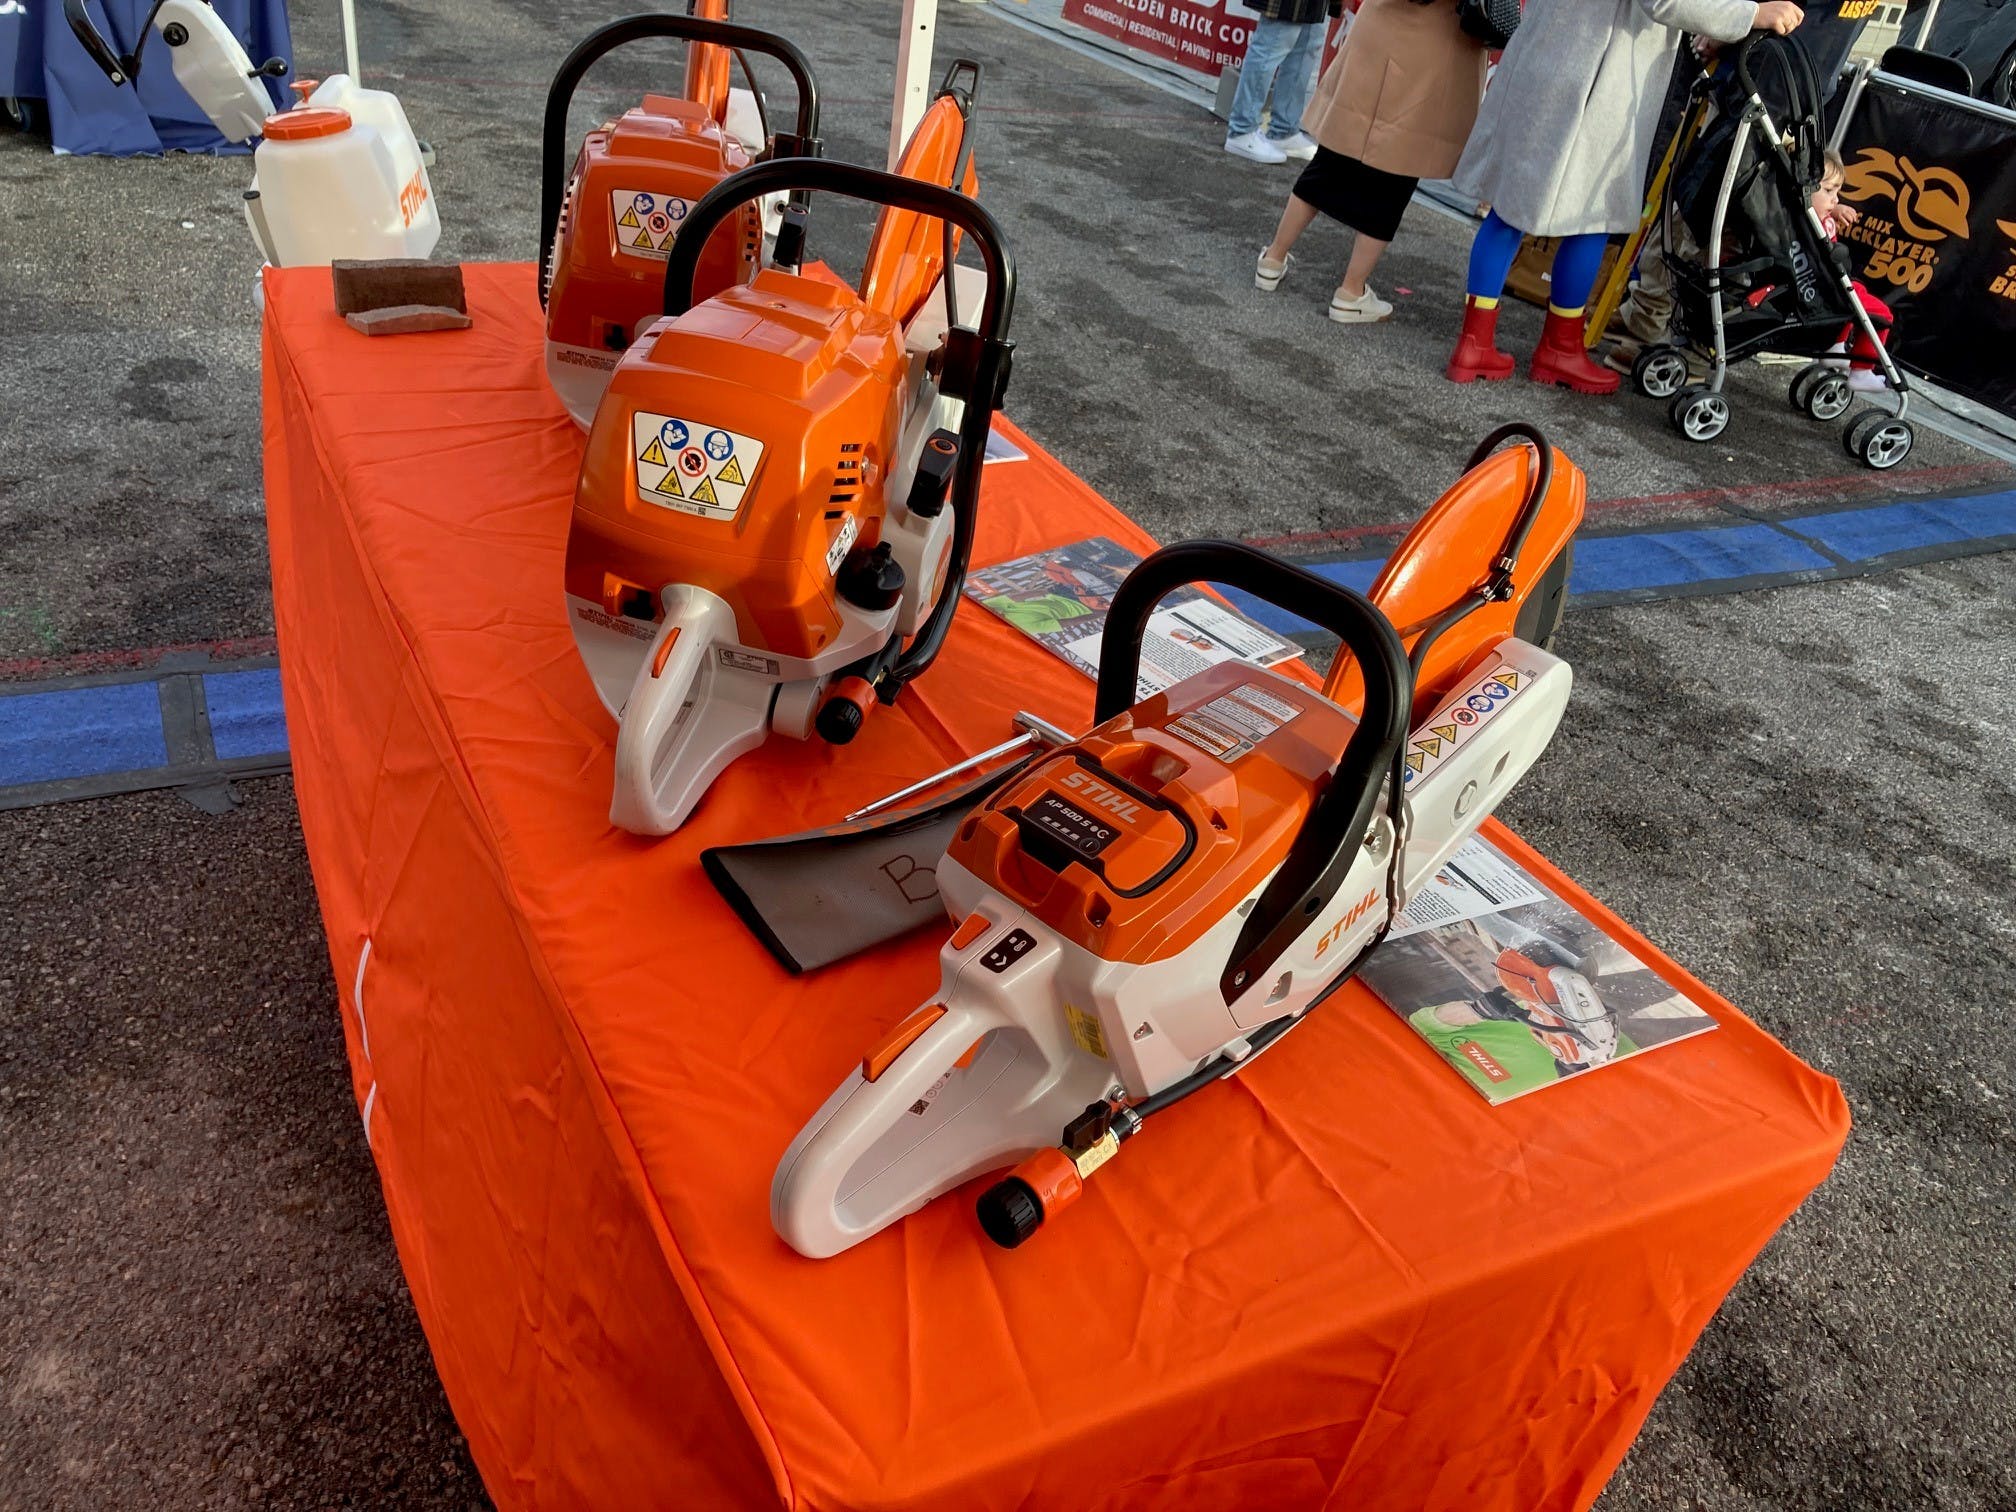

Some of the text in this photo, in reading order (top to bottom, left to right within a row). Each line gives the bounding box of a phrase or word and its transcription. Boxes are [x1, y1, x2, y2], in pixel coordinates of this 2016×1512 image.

[1083, 3, 1124, 28] COMMERCIAL
[1128, 20, 1176, 48] RESIDENTIAL
[1181, 40, 1210, 60] PAVING
[1170, 7, 1213, 37] BRICK
[400, 165, 427, 229] STIHL
[1836, 220, 1936, 265] RICKLAYER
[1864, 215, 1895, 235] MIX
[1863, 250, 1934, 293] 500
[1045, 799, 1093, 828] AP 500 S
[1060, 771, 1141, 824] STIHL
[879, 854, 940, 905] B
[1314, 887, 1381, 960] STIHL
[1468, 1046, 1504, 1078] STIHL
